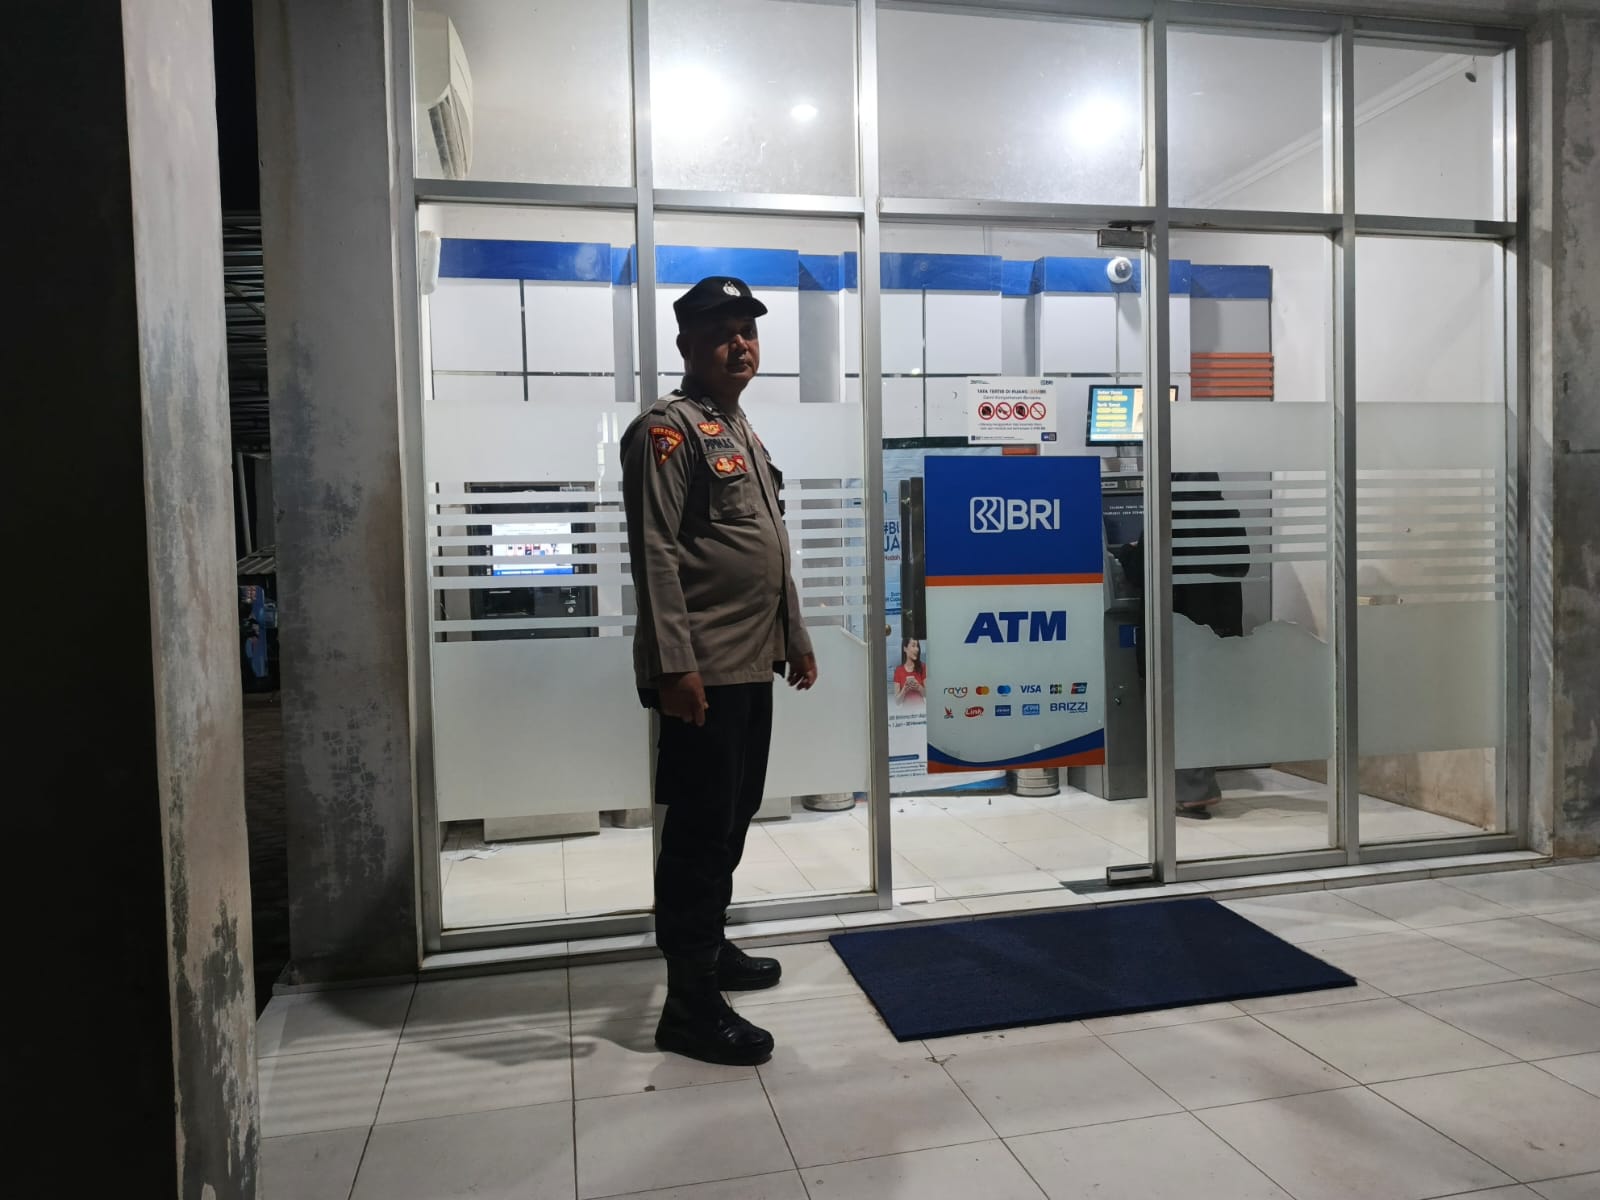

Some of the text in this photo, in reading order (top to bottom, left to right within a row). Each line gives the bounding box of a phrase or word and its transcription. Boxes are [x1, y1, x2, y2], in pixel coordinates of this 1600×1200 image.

[1007, 498, 1060, 531] BRI
[964, 611, 1067, 644] ATM
[1020, 684, 1042, 694] VISA
[1050, 702, 1088, 712] BRIZZI
